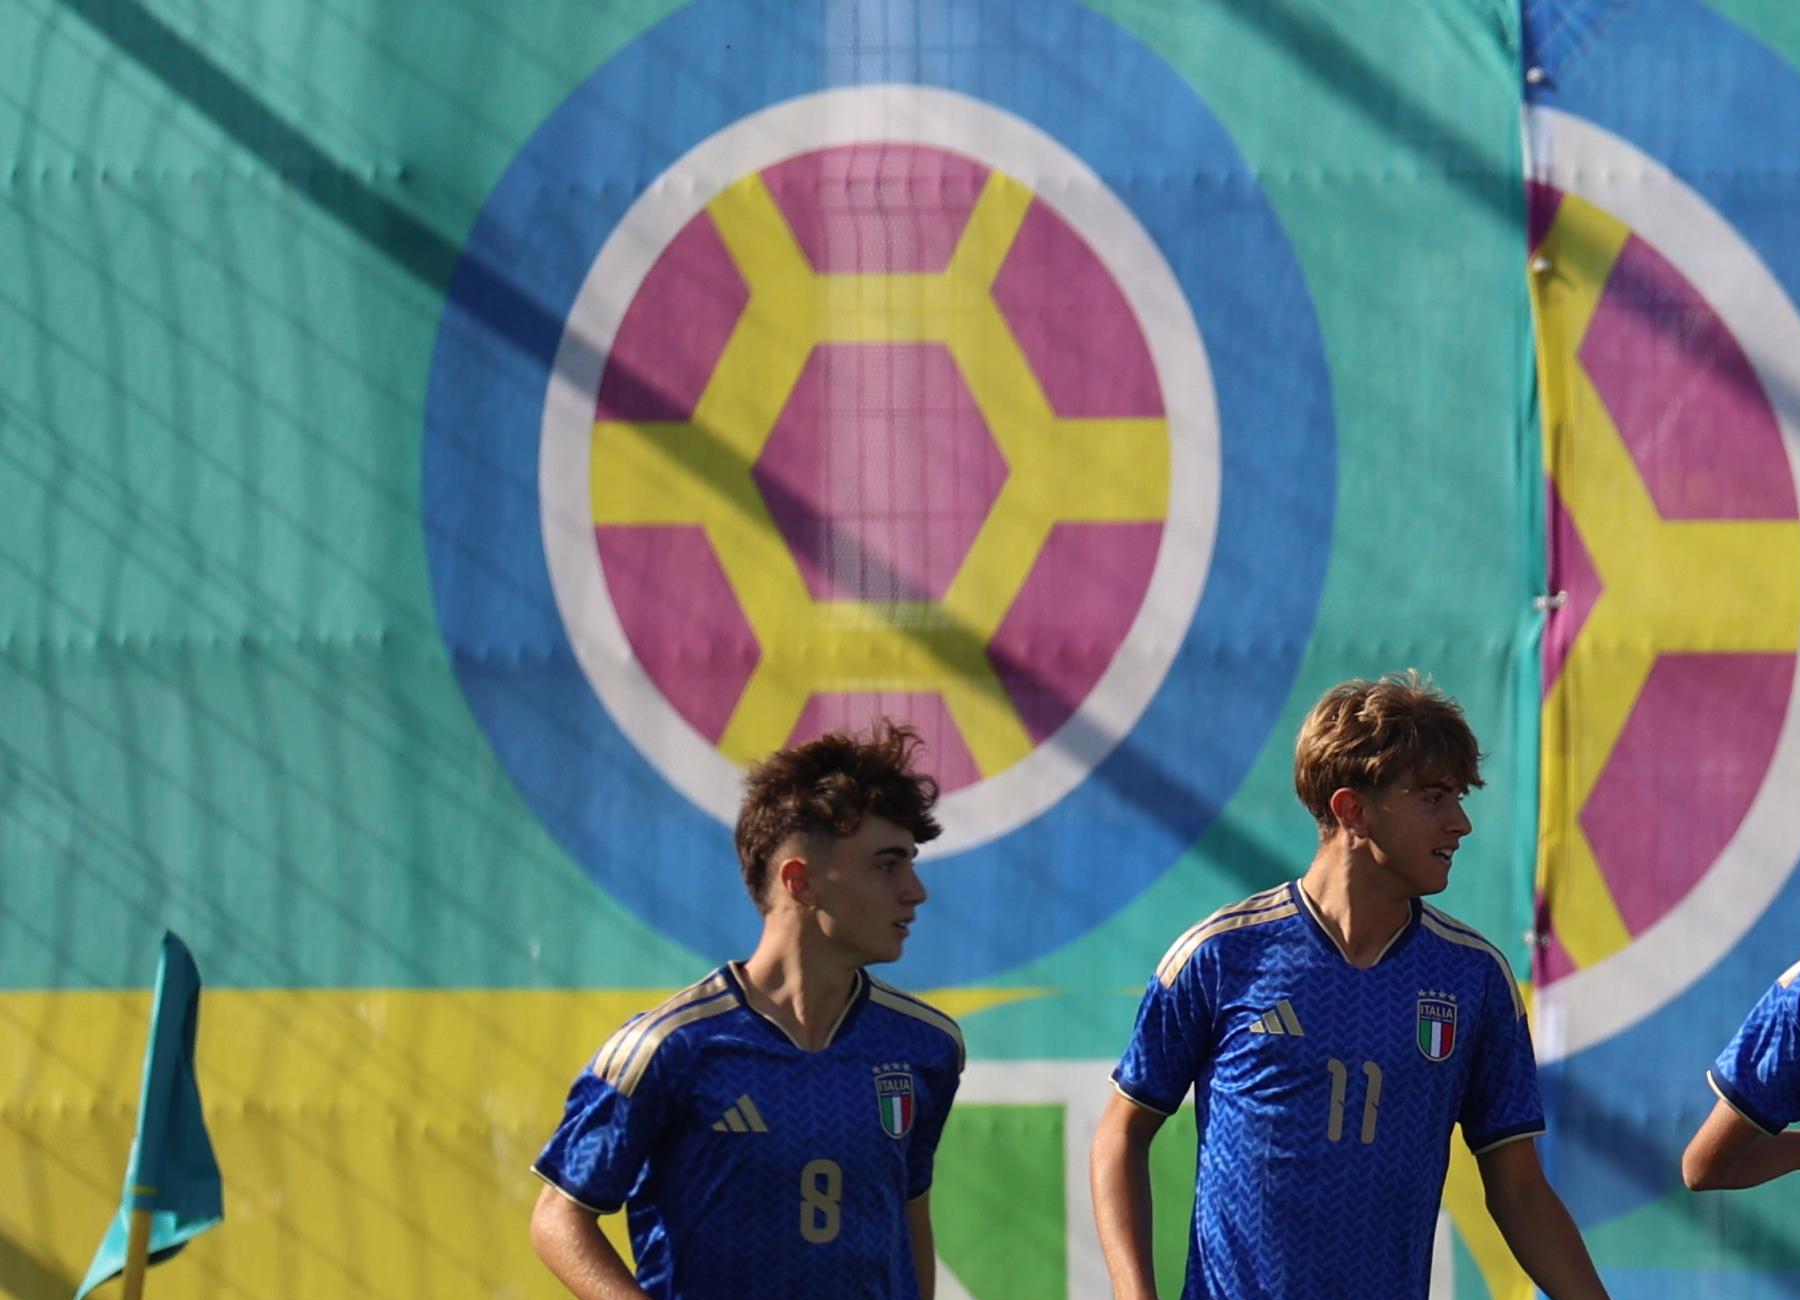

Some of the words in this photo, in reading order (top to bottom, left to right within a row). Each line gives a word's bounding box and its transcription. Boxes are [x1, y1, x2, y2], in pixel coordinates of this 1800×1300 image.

[1420, 1004, 1453, 1018] ITALIA
[1327, 1058, 1382, 1144] 11
[800, 1158, 842, 1244] 8
